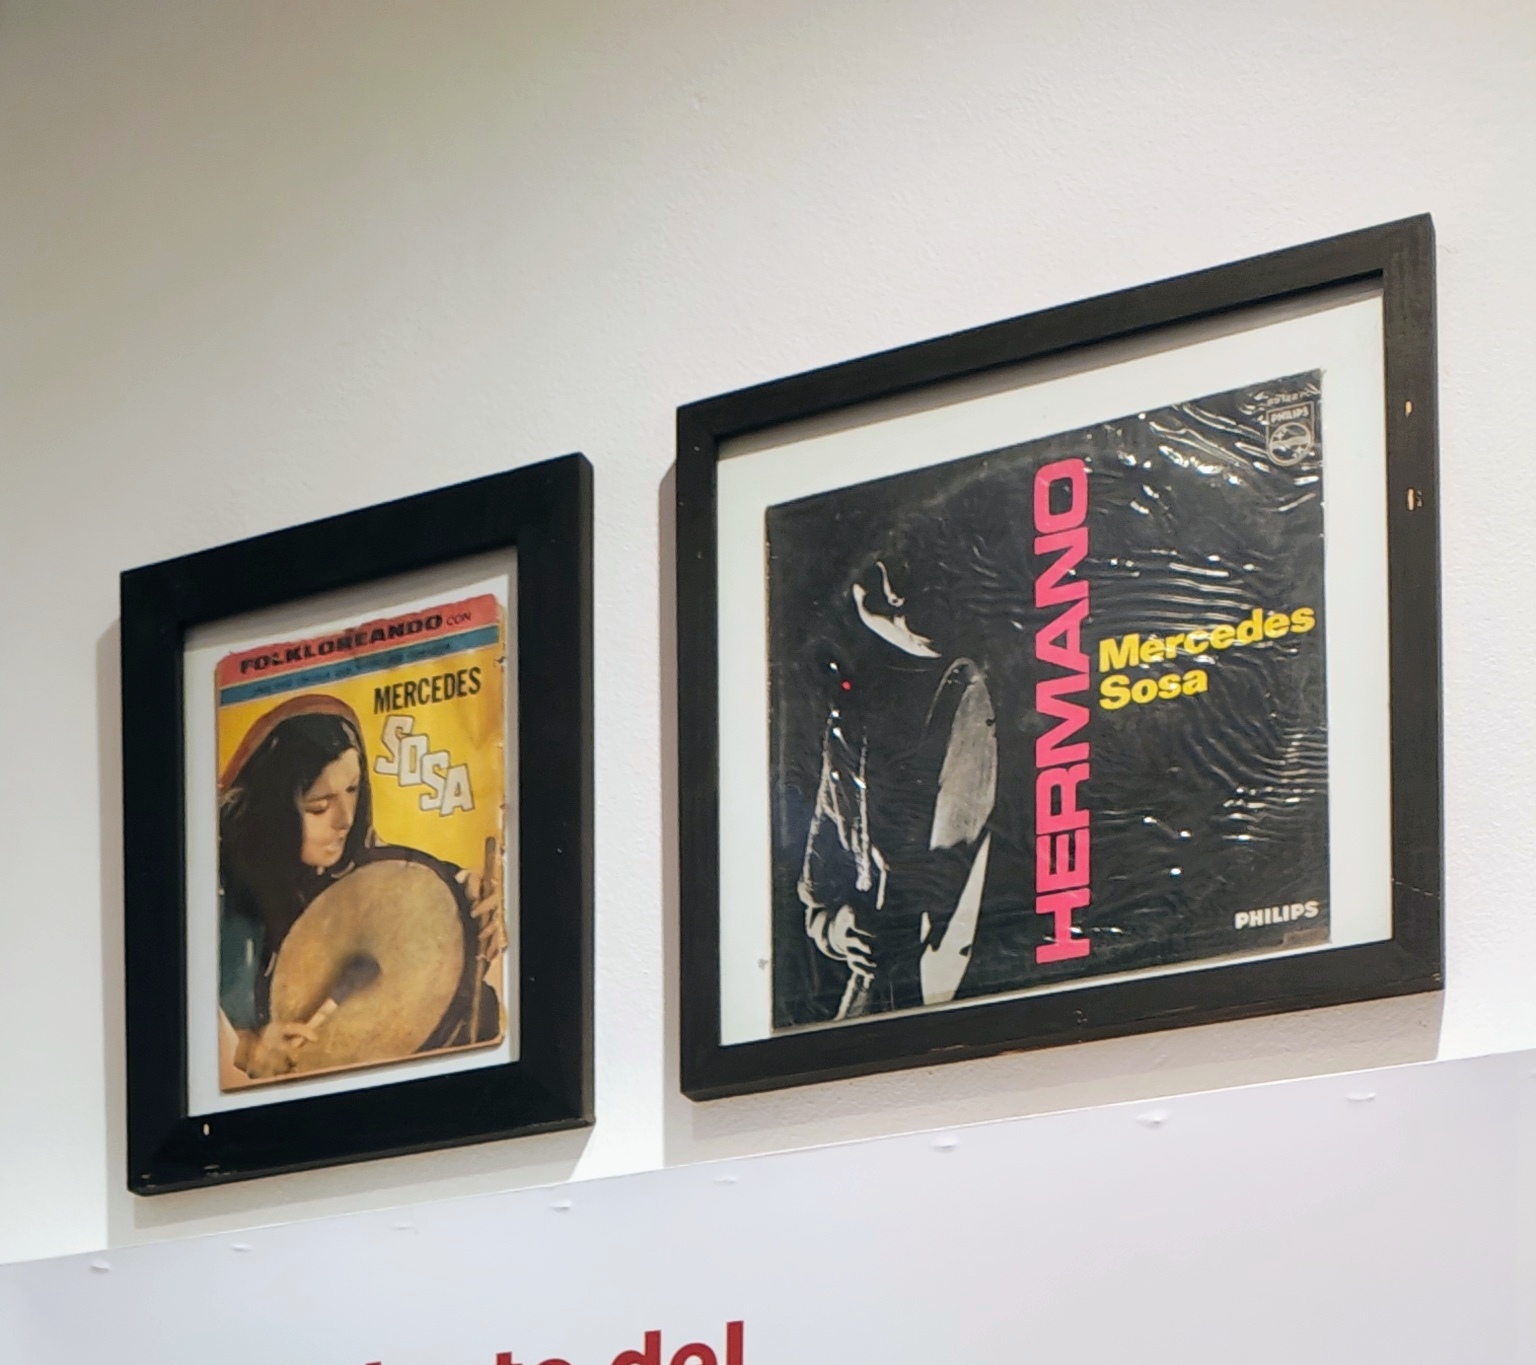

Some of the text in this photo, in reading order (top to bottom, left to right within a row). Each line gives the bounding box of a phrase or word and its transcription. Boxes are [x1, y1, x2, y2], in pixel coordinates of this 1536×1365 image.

[240, 614, 442, 674] FOLKLOREANDO
[1098, 607, 1315, 672] Mercedes
[374, 667, 481, 714] MERCEDES
[1034, 457, 1091, 964] HERMANO
[1099, 669, 1208, 709] Sosa
[374, 715, 474, 817] SOSA
[1234, 901, 1319, 930] PHILIPS
